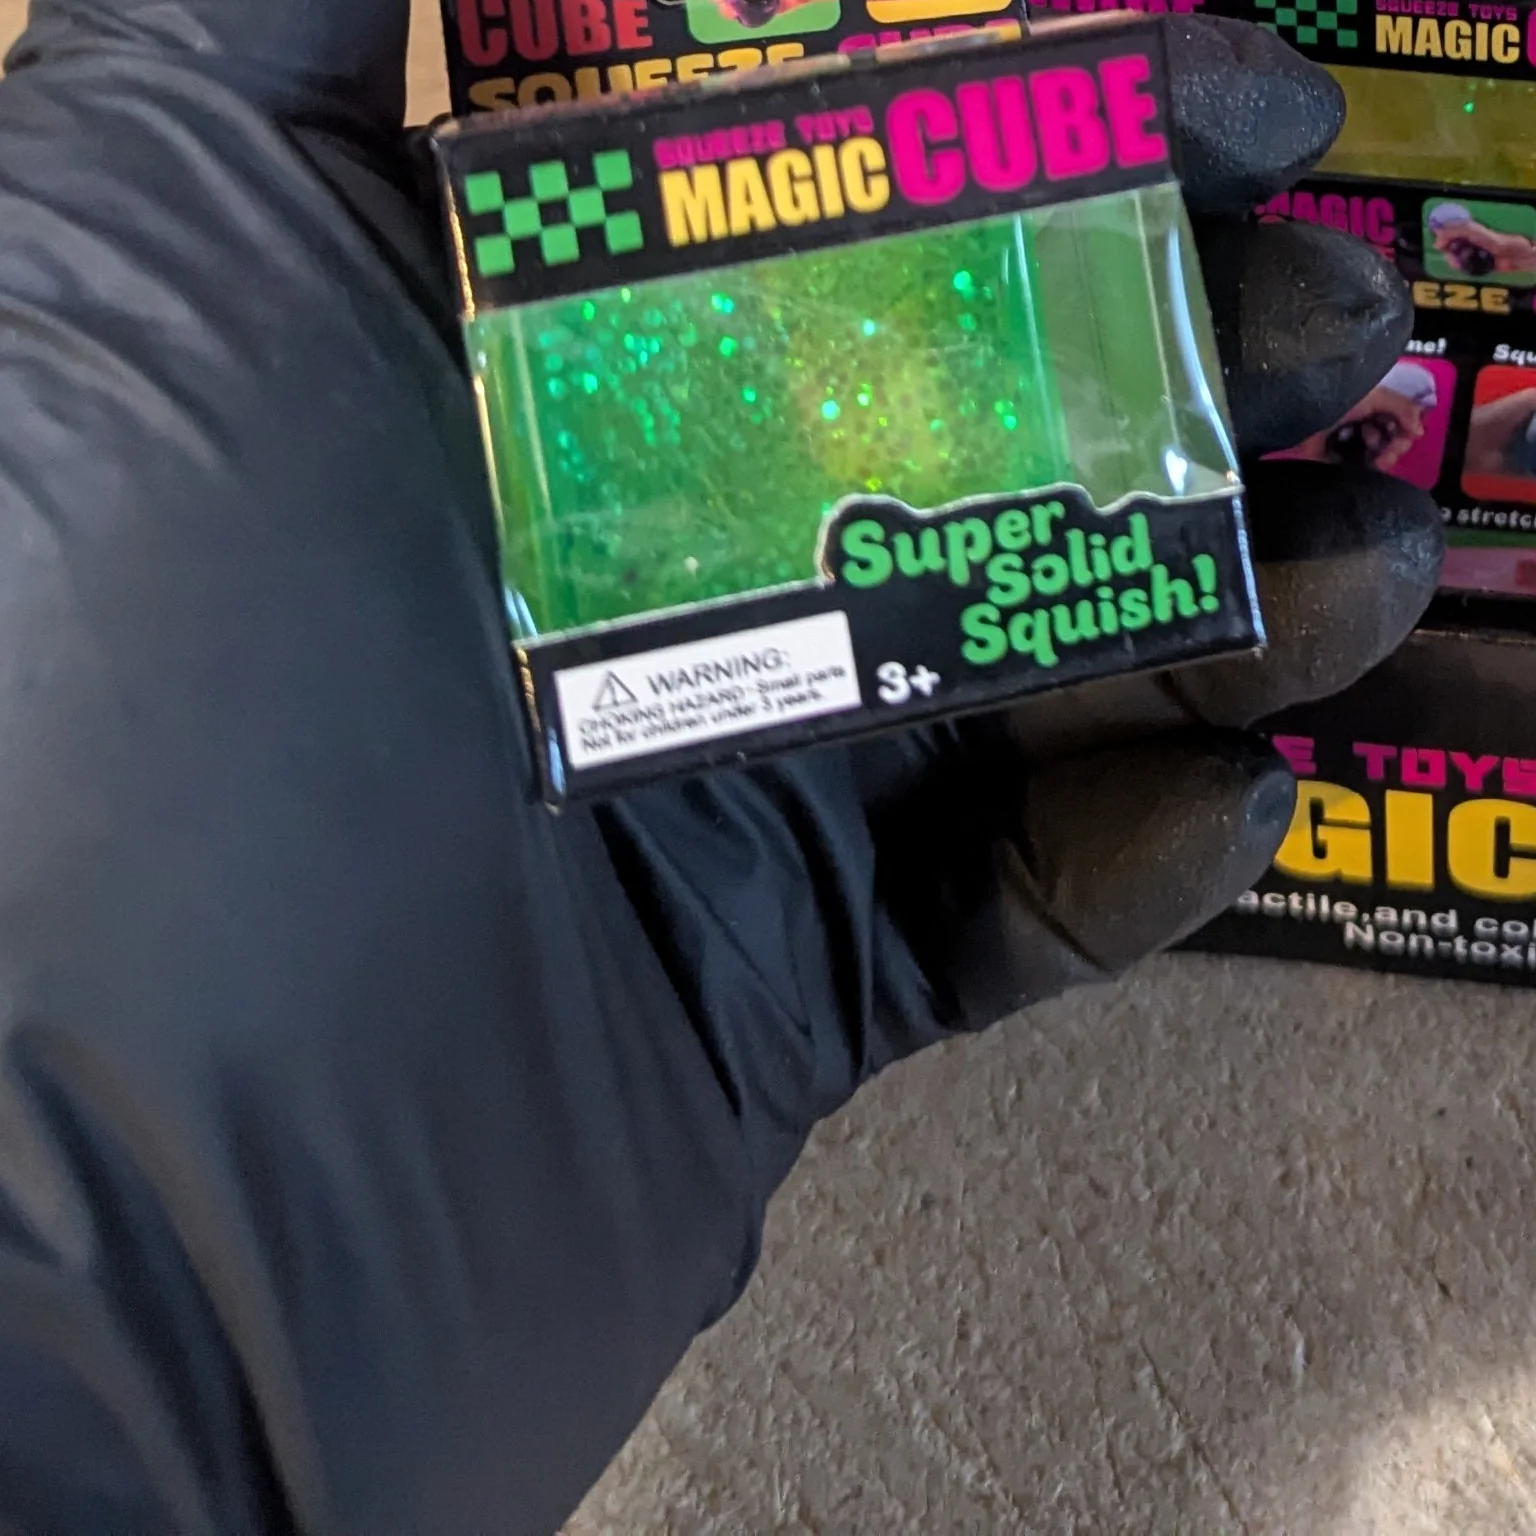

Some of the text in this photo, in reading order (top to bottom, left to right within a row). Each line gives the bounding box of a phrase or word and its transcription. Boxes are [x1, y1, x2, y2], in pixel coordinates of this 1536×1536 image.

[1375, 15, 1521, 64] MAGIC
[658, 54, 1169, 248] MAGIC CUBE
[1411, 282, 1511, 314] EZE
[840, 500, 1066, 588] Super
[985, 513, 1153, 607] Solid
[960, 554, 1218, 667] Squish!
[646, 646, 791, 696] WARNING:
[877, 660, 942, 706] 3+
[1236, 887, 1459, 933] actile,and
